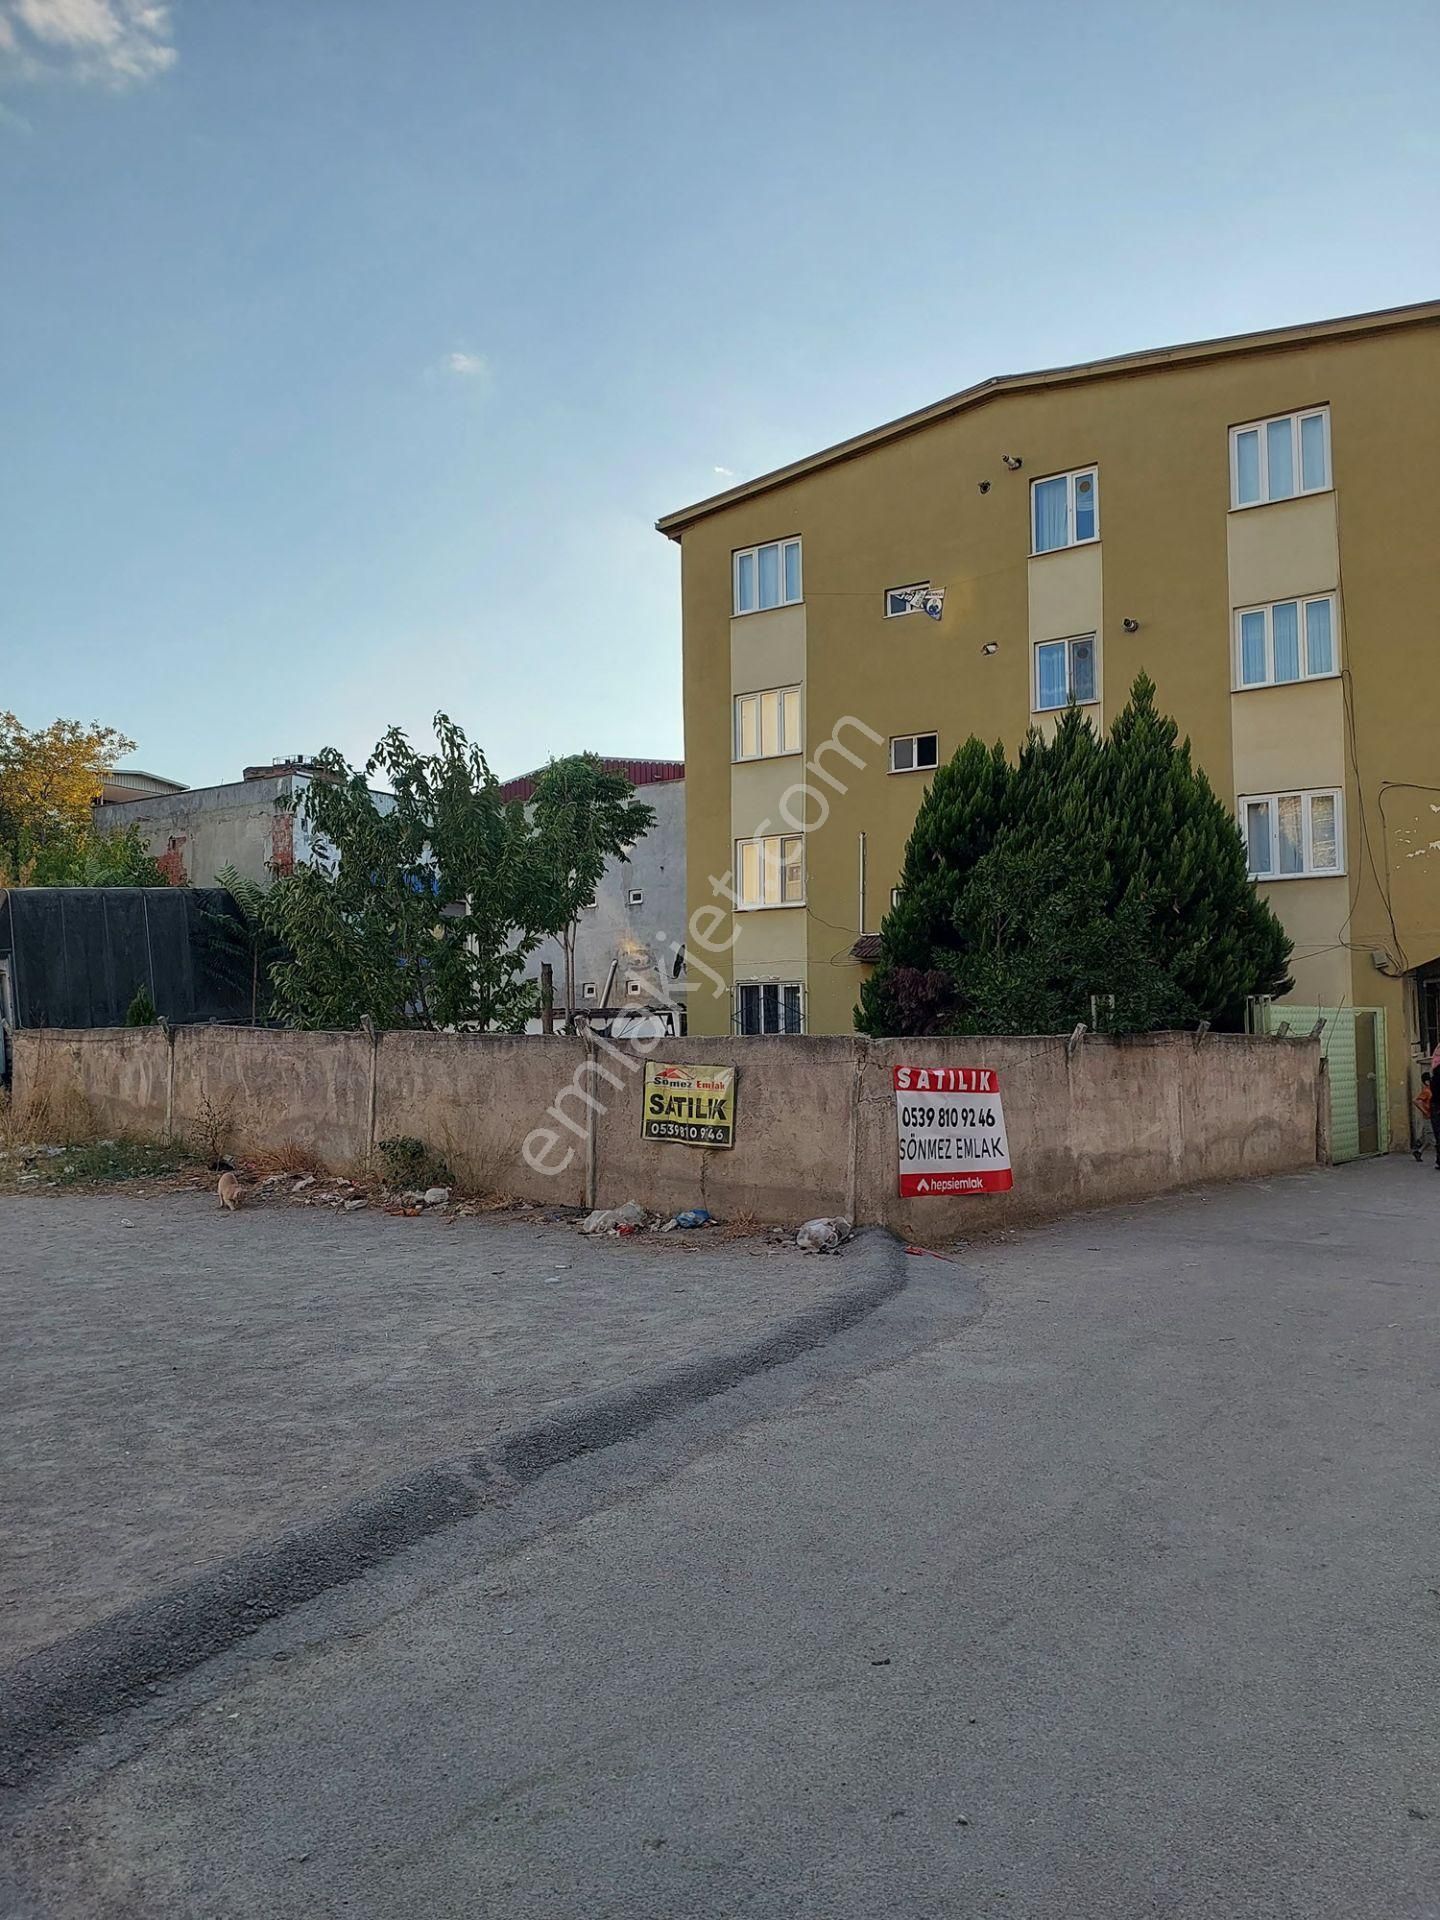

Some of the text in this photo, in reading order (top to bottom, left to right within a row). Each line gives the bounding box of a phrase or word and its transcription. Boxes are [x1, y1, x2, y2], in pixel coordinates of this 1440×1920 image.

[897, 1067, 991, 1091] SATILIK
[649, 1094, 727, 1120] SATILIK
[902, 1107, 996, 1128] 0539 810 92 46
[899, 1132, 1005, 1160] SÖNMEZ EMLAK
[930, 1177, 984, 1192] hepsiemlak
